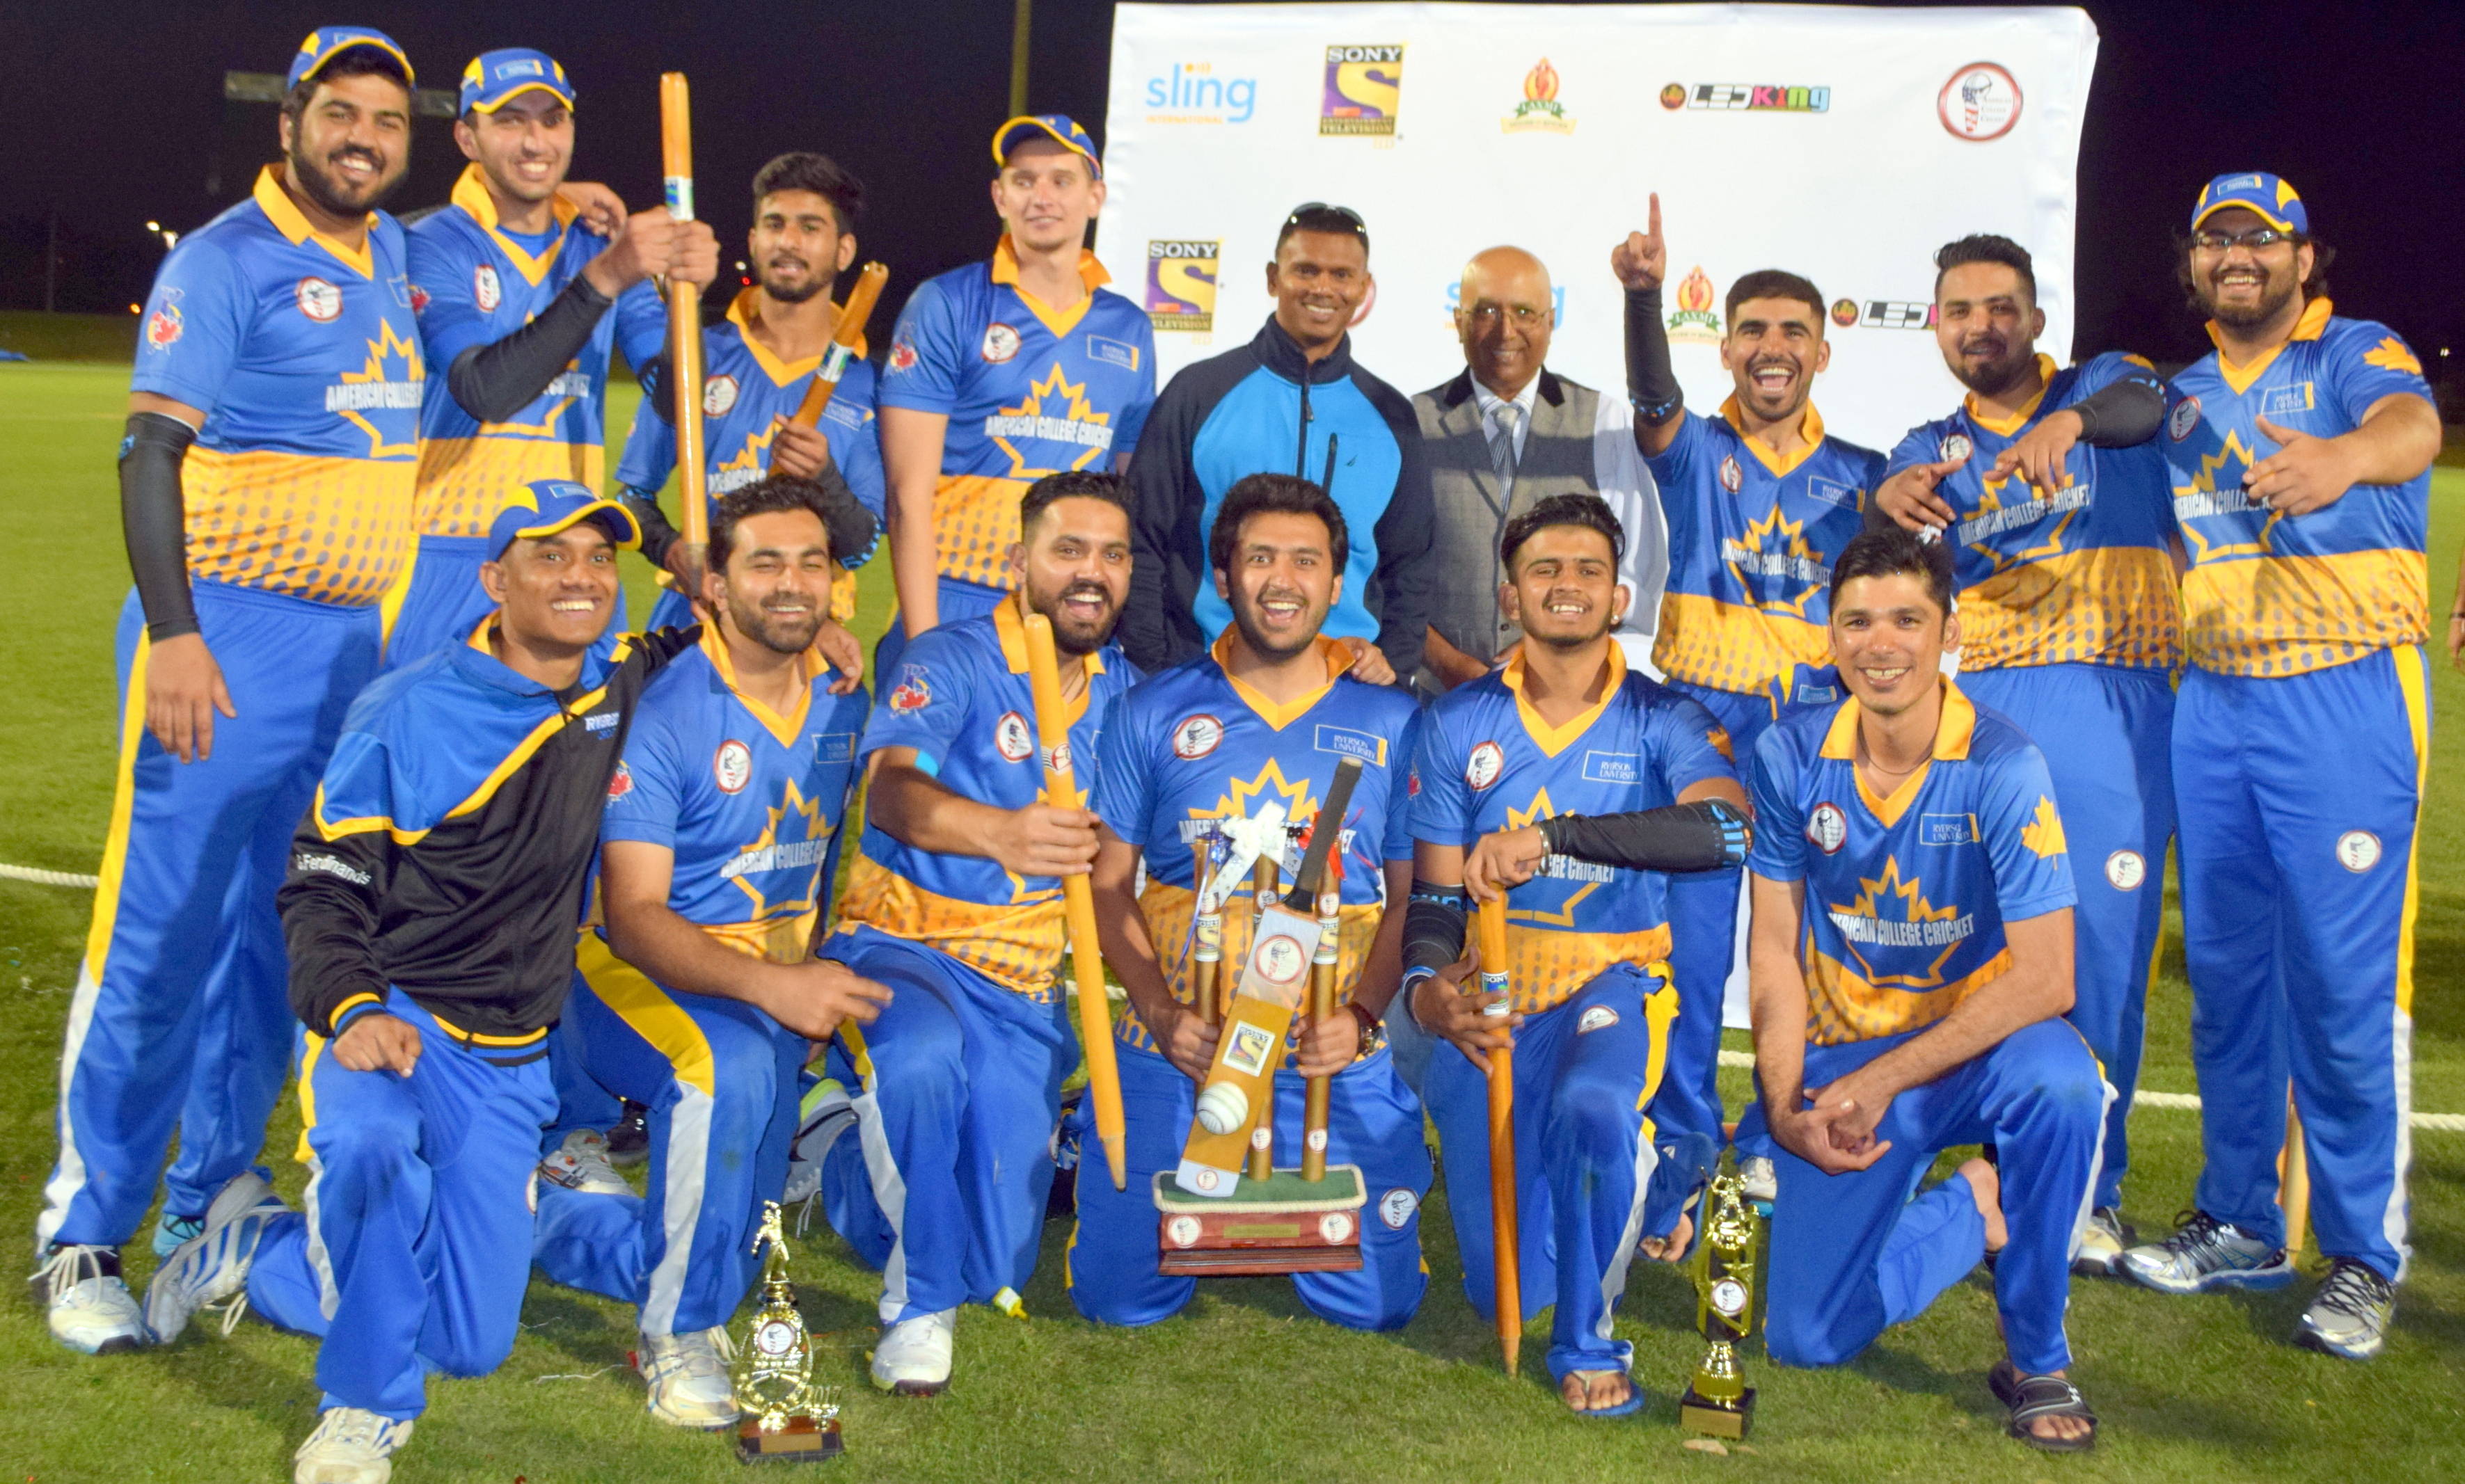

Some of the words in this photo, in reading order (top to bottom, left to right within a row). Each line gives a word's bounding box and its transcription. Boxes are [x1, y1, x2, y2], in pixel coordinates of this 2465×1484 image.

[1328, 47, 1401, 63] SONY
[1146, 63, 1257, 123] sling
[1146, 115, 1223, 125] INTERNATIONAL
[1322, 124, 1393, 134] TELEVISION
[1150, 243, 1216, 258] SONY
[1153, 320, 1211, 330] ELEVISION
[1675, 312, 1715, 324] LAXMI
[1037, 415, 1078, 443] COLLEGE
[1333, 735, 1368, 749] RYERSON
[1333, 742, 1376, 759] UNIVERSITY
[1601, 761, 1631, 771] RYERSON
[1600, 769, 1638, 781] UNIVERSITY
[1567, 855, 1615, 883] CRICKET
[1877, 918, 1923, 946] COLLEGE
[1923, 913, 1975, 947] CRICKET
